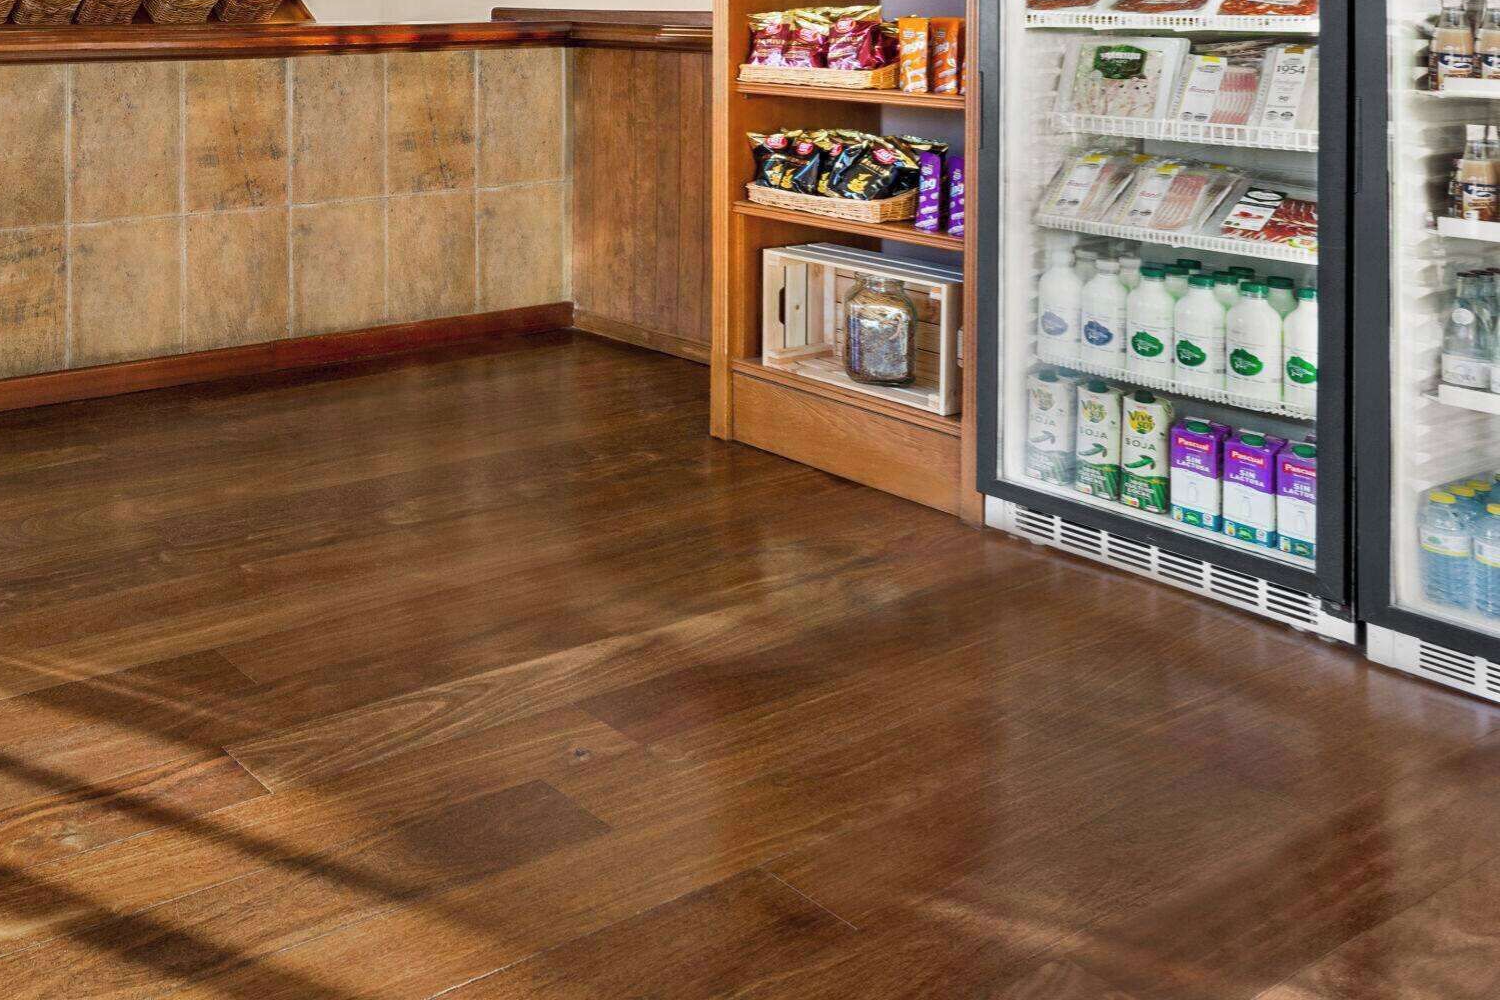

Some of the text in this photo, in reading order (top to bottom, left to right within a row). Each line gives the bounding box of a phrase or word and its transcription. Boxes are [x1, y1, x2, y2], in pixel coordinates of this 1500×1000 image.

[1277, 65, 1305, 74] 1954
[1124, 437, 1157, 452] SOJA
[1177, 436, 1210, 452] Pascual
[1185, 455, 1202, 465] SIN
[1231, 450, 1264, 466] Pascual
[1176, 459, 1211, 474] LACTOSA
[1239, 468, 1256, 480] SIN
[1283, 463, 1316, 478] Pascua
[1229, 472, 1266, 488] LACTOSA
[1293, 482, 1311, 493] SIN
[1282, 486, 1316, 500] LACTOS
